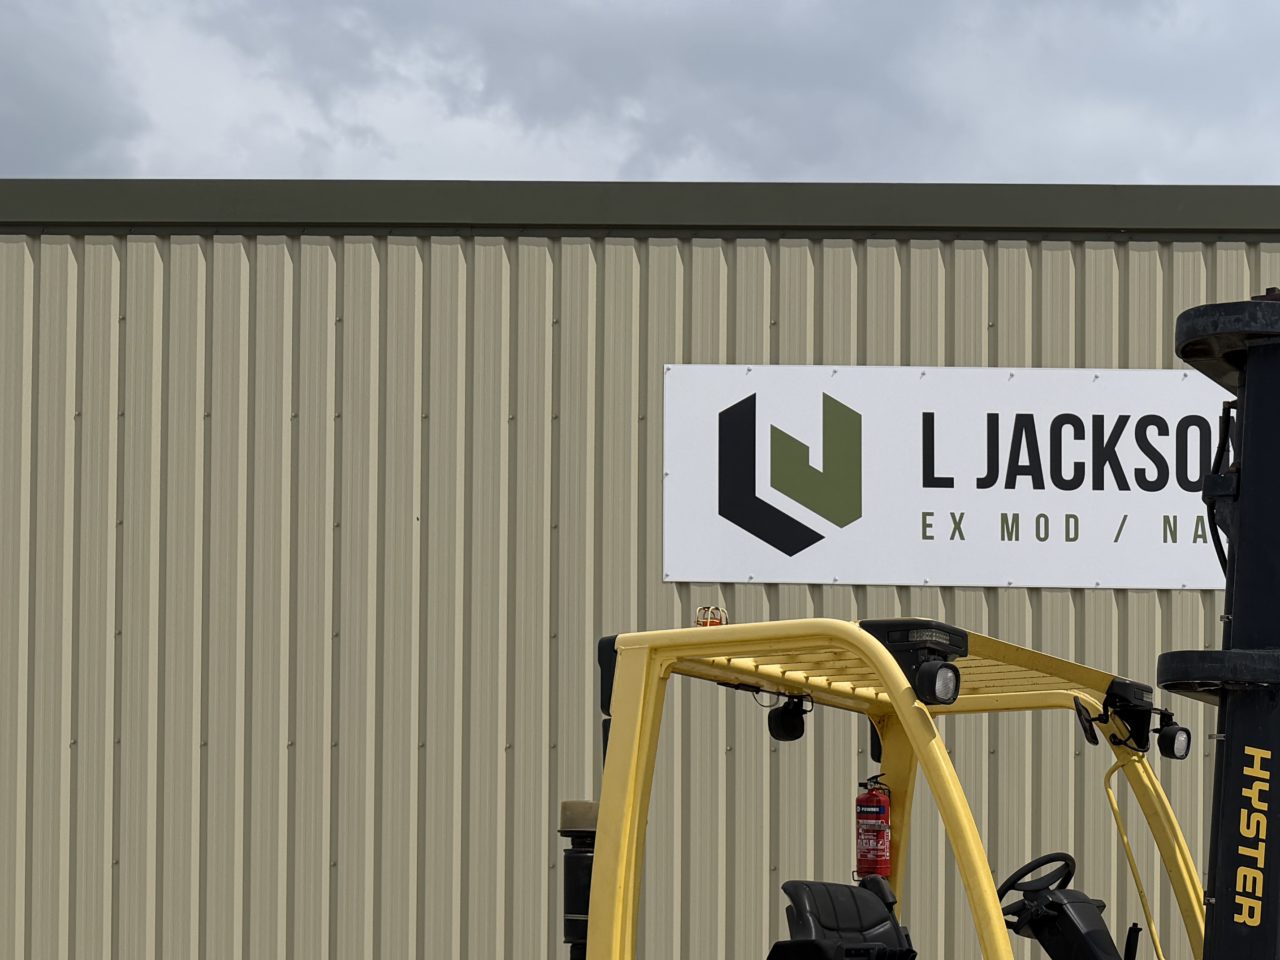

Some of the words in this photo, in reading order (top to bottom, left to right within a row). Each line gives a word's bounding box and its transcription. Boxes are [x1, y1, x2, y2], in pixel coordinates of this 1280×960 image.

[922, 411, 955, 489] L
[921, 511, 966, 541] EX
[1000, 512, 1080, 543] MOD
[1113, 514, 1129, 543] /
[1233, 745, 1273, 928] HYSTER
